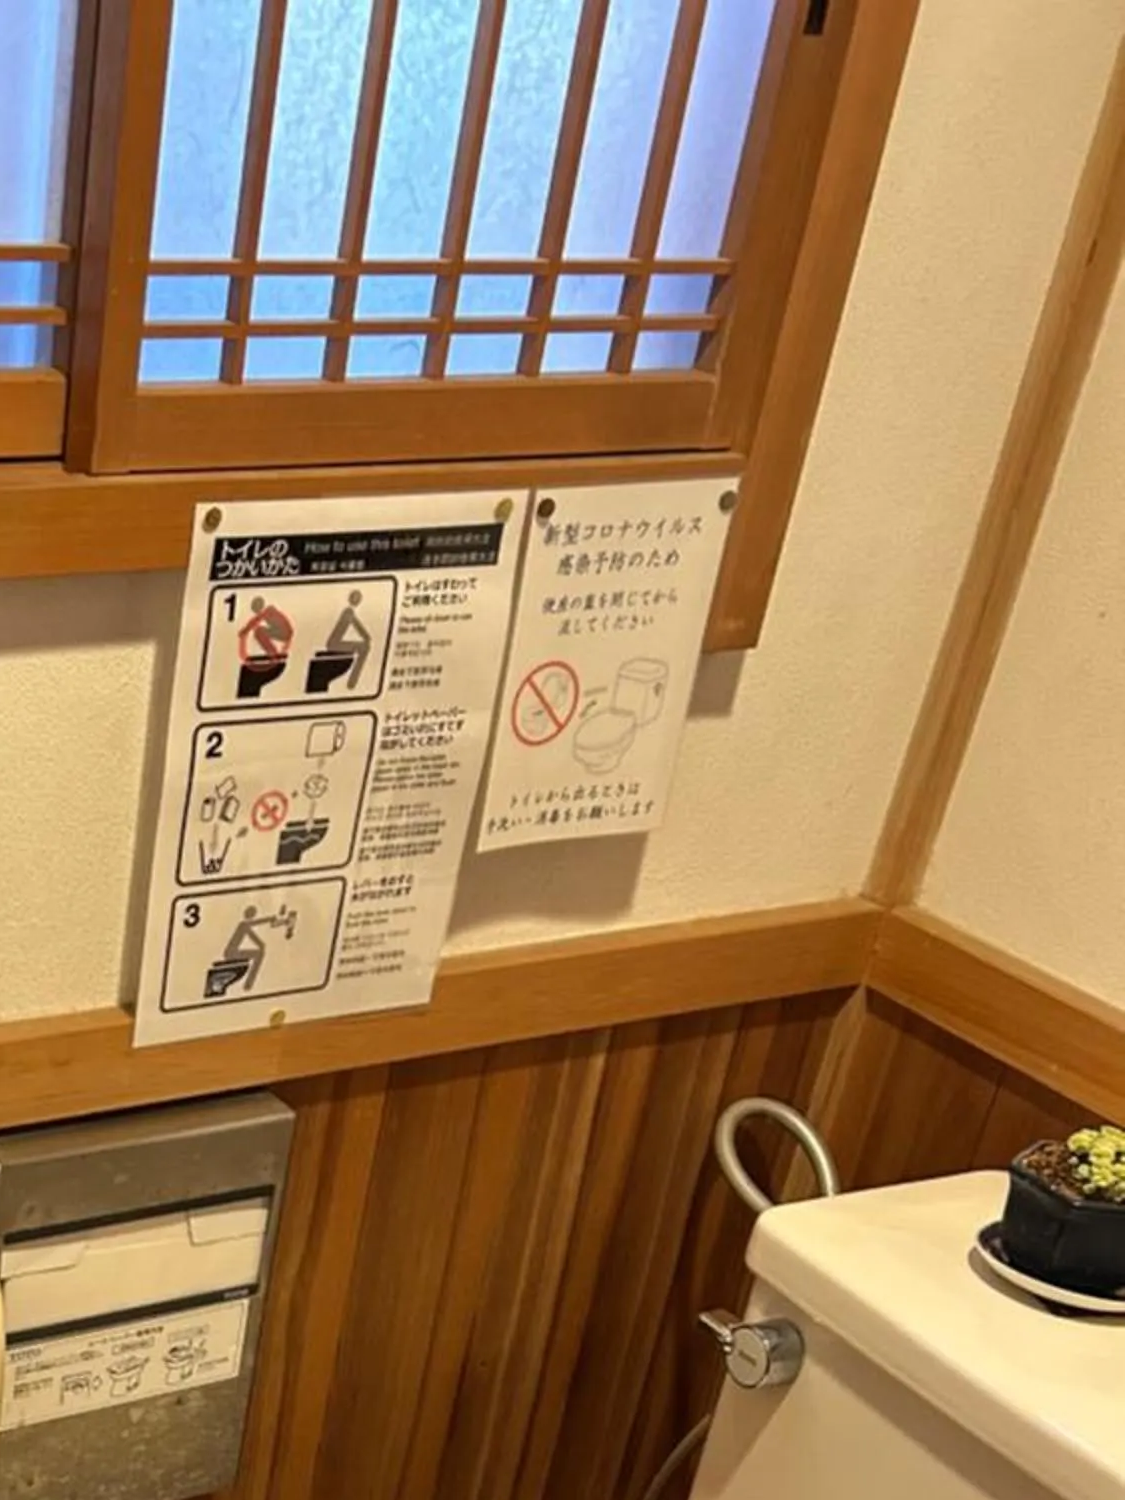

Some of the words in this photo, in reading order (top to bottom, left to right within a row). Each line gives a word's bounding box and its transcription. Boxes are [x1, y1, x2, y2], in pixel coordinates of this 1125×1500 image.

[543, 516, 703, 546] 新型コロナウイルス
[223, 539, 290, 559] トイレの
[557, 549, 680, 575] 感染予防のため
[215, 555, 300, 578] つかいかた
[224, 594, 237, 622] 1
[384, 707, 467, 722] トイレットペーパー
[205, 731, 224, 760] 2
[183, 903, 201, 929] 3
